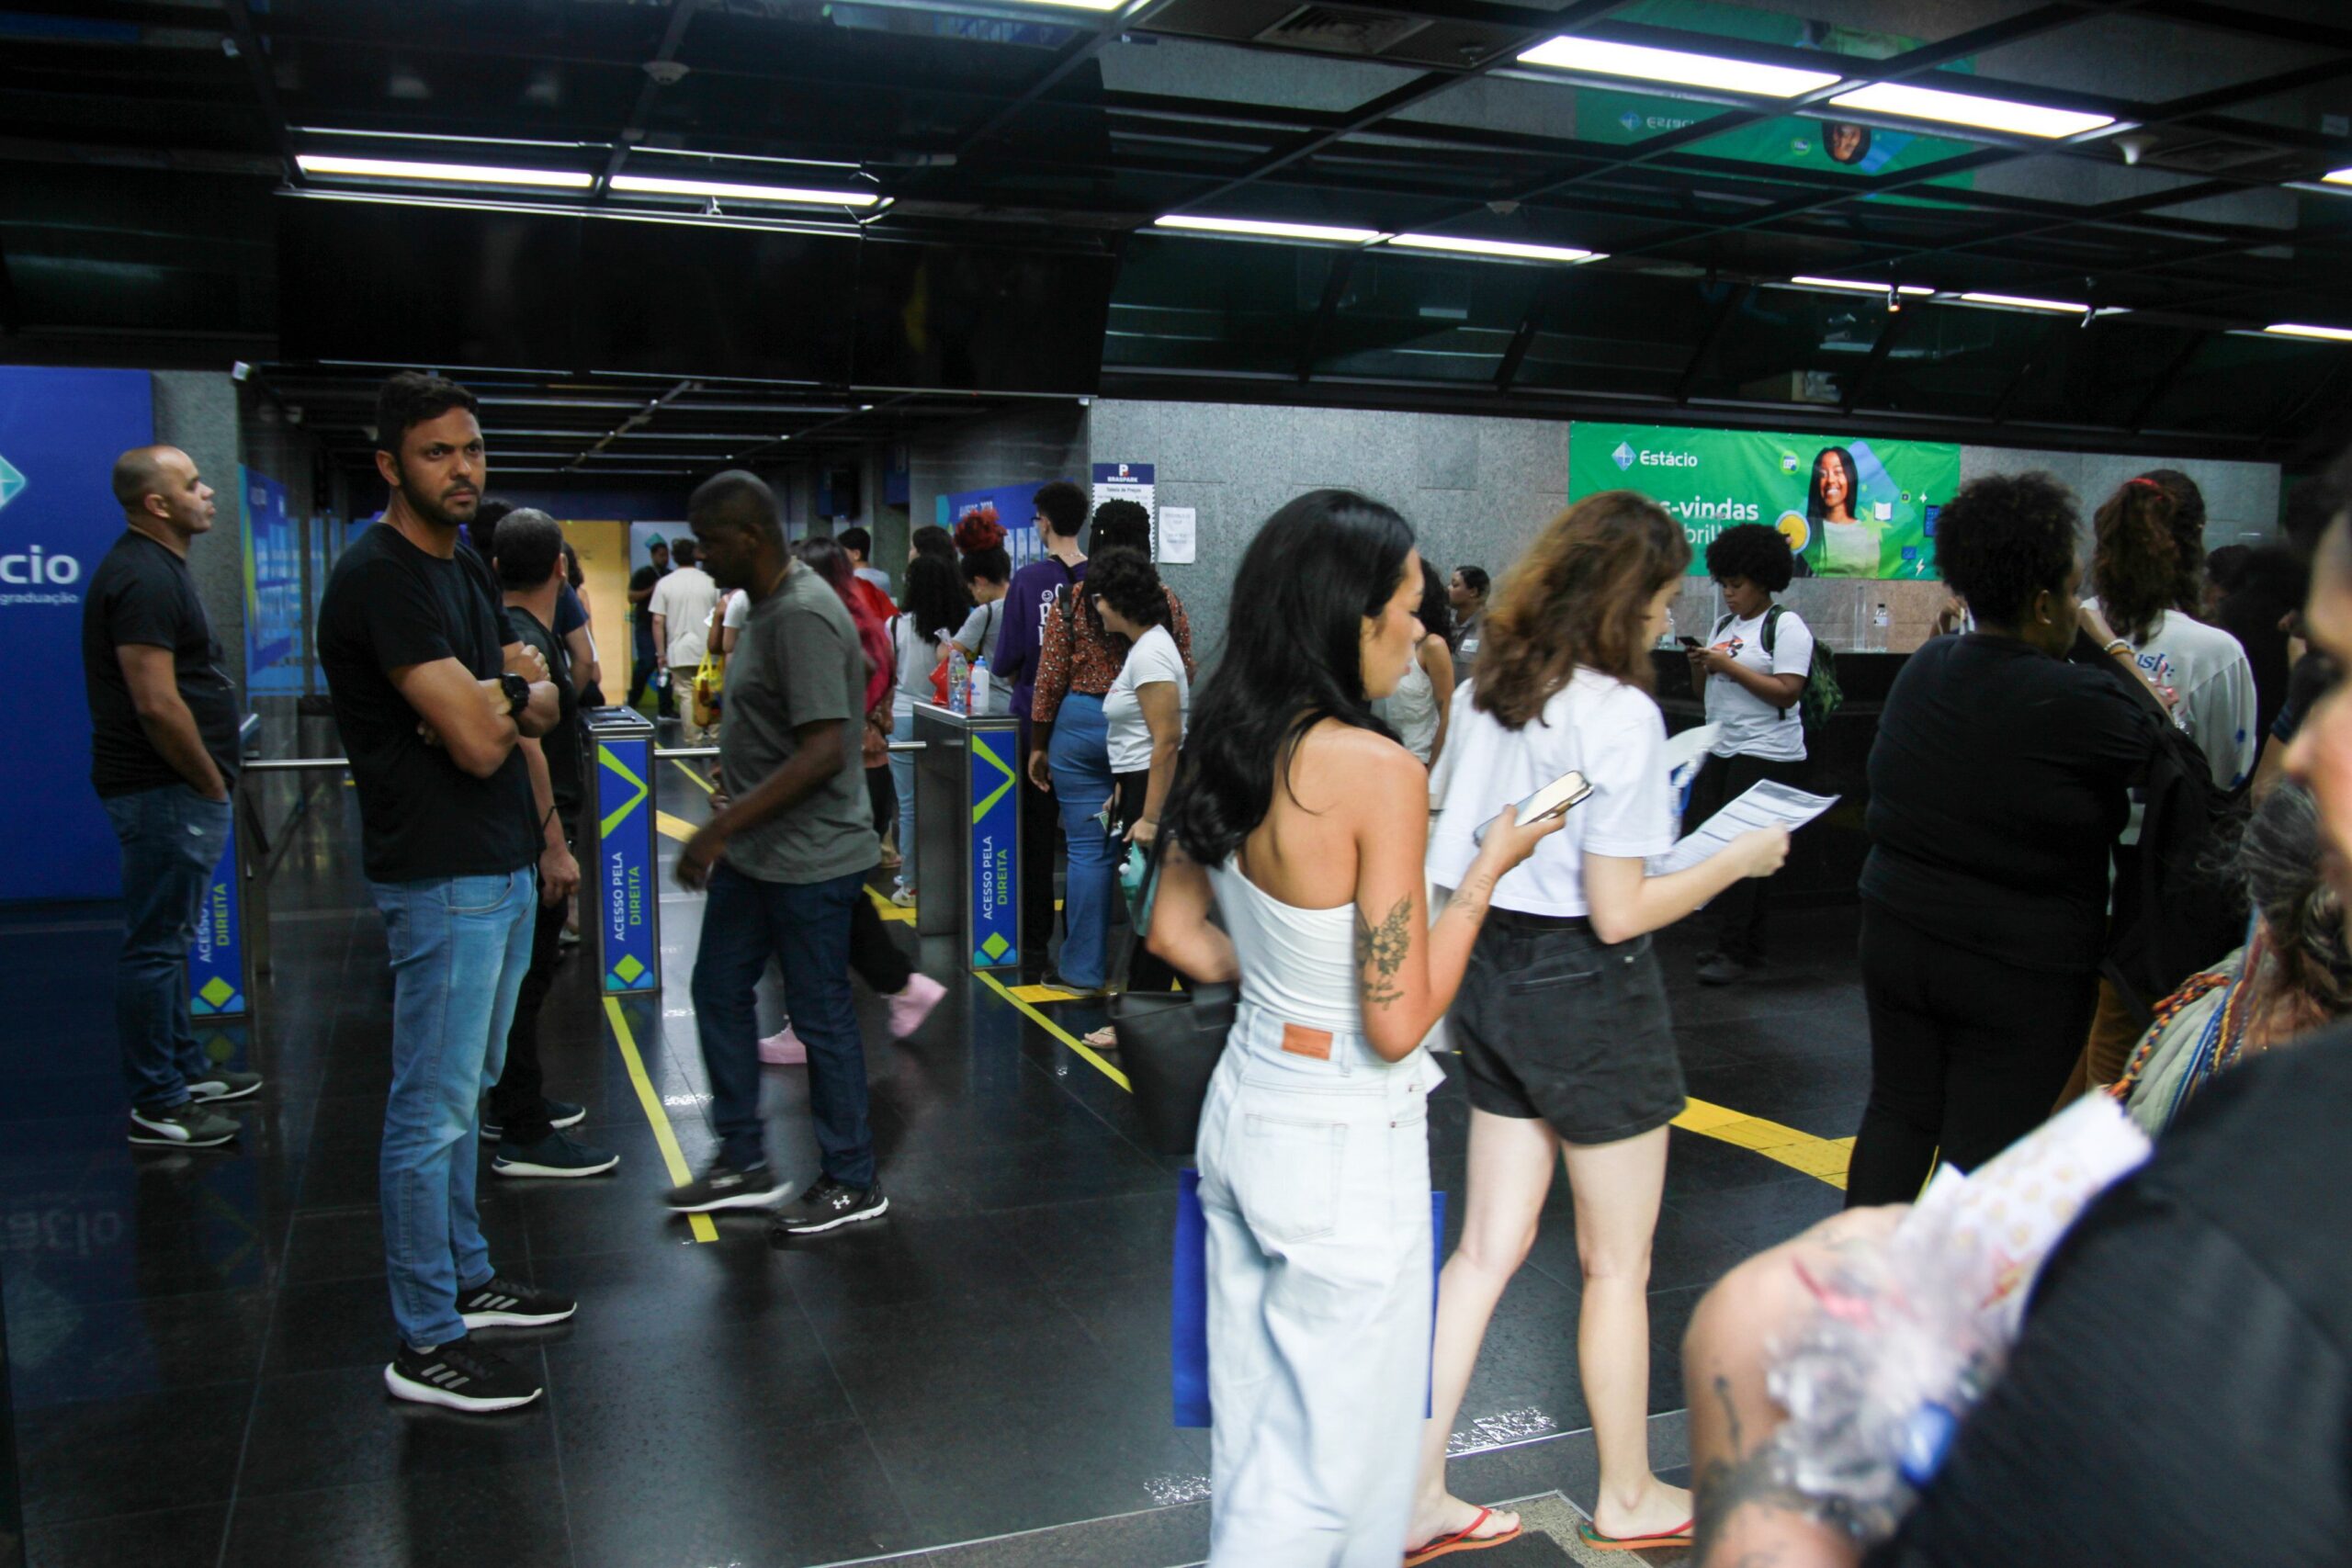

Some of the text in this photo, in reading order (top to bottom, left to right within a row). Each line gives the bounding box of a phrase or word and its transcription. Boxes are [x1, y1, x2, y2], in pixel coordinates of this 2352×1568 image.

[1640, 450, 1698, 468] Estácio
[612, 852, 625, 942] ACESSO PELA
[628, 866, 641, 926] DIREITA
[983, 836, 993, 920] ACESSO PELA
[996, 849, 1008, 906] DIREITA
[213, 883, 230, 947] DIREITA
